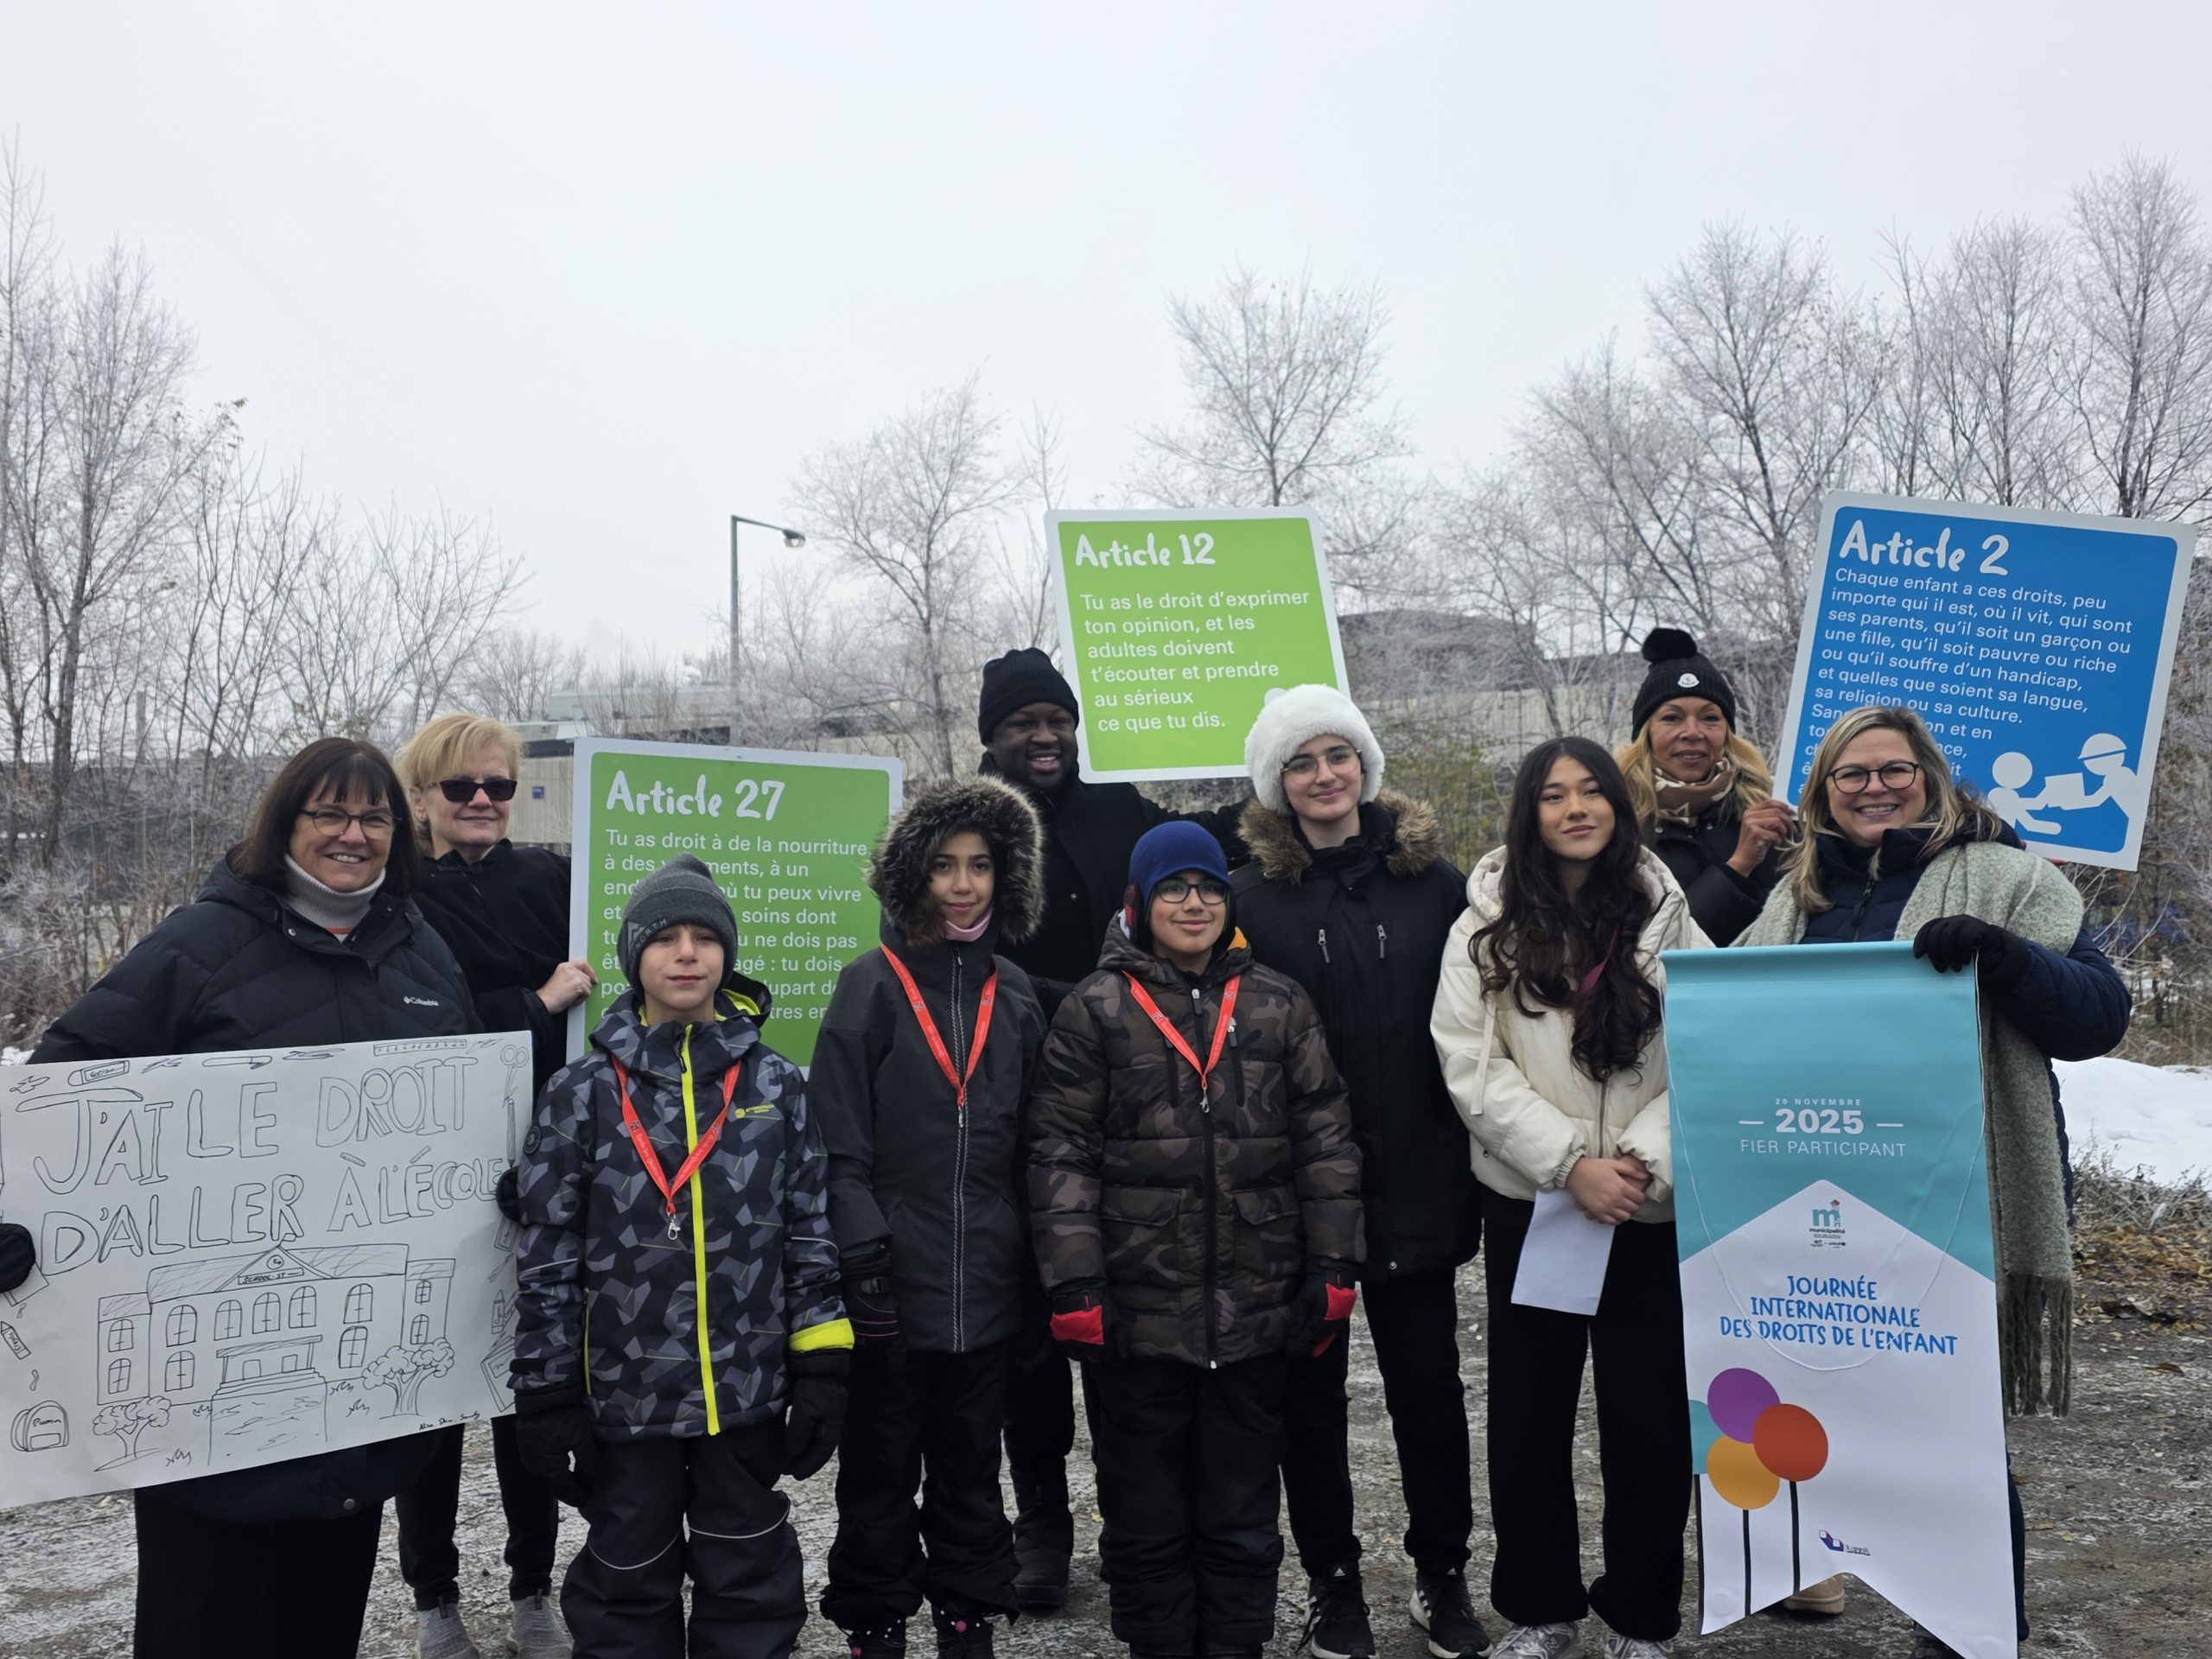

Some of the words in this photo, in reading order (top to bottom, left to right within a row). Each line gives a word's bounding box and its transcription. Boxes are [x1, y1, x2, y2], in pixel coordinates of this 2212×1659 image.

[1075, 532, 1171, 569] Article
[1179, 532, 1216, 565] 12
[1839, 519, 1966, 572] Article
[1980, 535, 2009, 575] 2
[1080, 594, 1103, 610] Tu
[1110, 598, 1131, 610] as
[1136, 594, 1154, 609] le
[1159, 591, 1204, 608] droit
[1209, 589, 1309, 609] d'exprimer
[1835, 568, 1898, 588] Chaque
[1904, 577, 1958, 594] enfant
[1963, 585, 1973, 594] a
[1978, 587, 2006, 598] ces
[2012, 587, 2067, 607] droits,
[2073, 596, 2107, 610] peu
[1831, 588, 1897, 607] importe
[1902, 597, 1929, 612] qui
[1934, 599, 1943, 612] il
[1948, 604, 1978, 618] est,
[1984, 605, 2005, 619] où
[2012, 607, 2022, 620] il
[2027, 610, 2052, 626] vit,
[2059, 614, 2088, 629] qui
[2093, 620, 2133, 633] sont
[1084, 620, 1116, 634] ton
[1122, 616, 1199, 636] opinion,
[1205, 617, 1224, 631] et
[1228, 614, 1255, 630] les
[1828, 610, 1856, 622] ses
[1860, 614, 1928, 632] parents,
[1934, 620, 1971, 636] qu'il
[1976, 626, 2008, 639] soit
[2014, 632, 2035, 643] un
[2041, 634, 2101, 652] garçon
[2108, 642, 2131, 653] ou
[1088, 641, 1157, 658] adultes
[1163, 639, 1235, 656] doivent
[1825, 630, 1855, 643] une
[1860, 630, 1895, 648] fille,
[1901, 637, 1938, 652] qu'il
[1943, 642, 1974, 656] soit
[1980, 647, 2039, 664] pauvre
[2045, 656, 2067, 667] ou
[2073, 656, 2117, 673] riche
[1090, 665, 1175, 683] t'écouter
[1182, 665, 1200, 680] et
[1205, 661, 1279, 683] prendre
[1821, 649, 1842, 660] ou
[1847, 651, 1884, 666] qu'il
[1889, 657, 1948, 673] souffre
[1954, 662, 1991, 679] d'un
[1997, 666, 2082, 691] handicap,
[1095, 694, 1117, 707] au
[1122, 689, 1193, 706] sérieux
[1818, 667, 1834, 679] et
[1839, 671, 1899, 688] quelles
[1904, 679, 1936, 692] que
[1940, 682, 1993, 699] soient
[1999, 690, 2018, 702] sa
[2023, 690, 2088, 712] langue,
[1815, 688, 1833, 699] sa
[1839, 690, 1901, 707] religion
[1907, 698, 1929, 711] ou
[1934, 702, 1953, 715] sa
[1958, 704, 2023, 723] culture.
[1098, 719, 1120, 732] ce
[1125, 716, 1161, 734] que
[1166, 715, 1185, 728] tu
[1192, 711, 1224, 728] dis.
[1950, 723, 1967, 736] et
[1972, 728, 1992, 740] en
[606, 770, 722, 817] Article
[735, 779, 785, 821] 27
[606, 830, 627, 846] Tu
[635, 835, 655, 847] as
[662, 832, 706, 849] droit
[712, 834, 721, 849] à
[728, 835, 752, 851] de
[757, 836, 772, 852] la
[605, 854, 615, 870] à
[622, 855, 655, 872] des
[770, 860, 780, 876] à
[786, 865, 808, 877] un
[744, 885, 760, 899] tu
[768, 887, 811, 902] peux
[817, 886, 861, 902] vivre
[604, 906, 622, 920] et
[742, 907, 790, 924] soins
[796, 908, 836, 925] dont
[755, 935, 777, 948] ne
[783, 931, 820, 948] dois
[826, 936, 857, 951] pas
[781, 957, 798, 971] tu
[805, 956, 842, 972] dois
[16, 1087, 174, 1195] J'AI
[187, 1082, 278, 1159] LE
[315, 1057, 478, 1147] DROIT
[1776, 1109, 1864, 1135] 2025
[1740, 1140, 1778, 1154] FIER
[1788, 1141, 1906, 1157] PARTICIPANT
[40, 1173, 304, 1277] D'ALLER
[326, 1152, 372, 1232] À
[1787, 1275, 1877, 1301] JOURNÉE
[1751, 1296, 1919, 1329] INTERNATIONALE
[1719, 1316, 1752, 1338] DES
[1758, 1320, 1827, 1346] DROITS
[1832, 1325, 1854, 1347] DE
[1861, 1328, 1958, 1356] L'ENFANT
